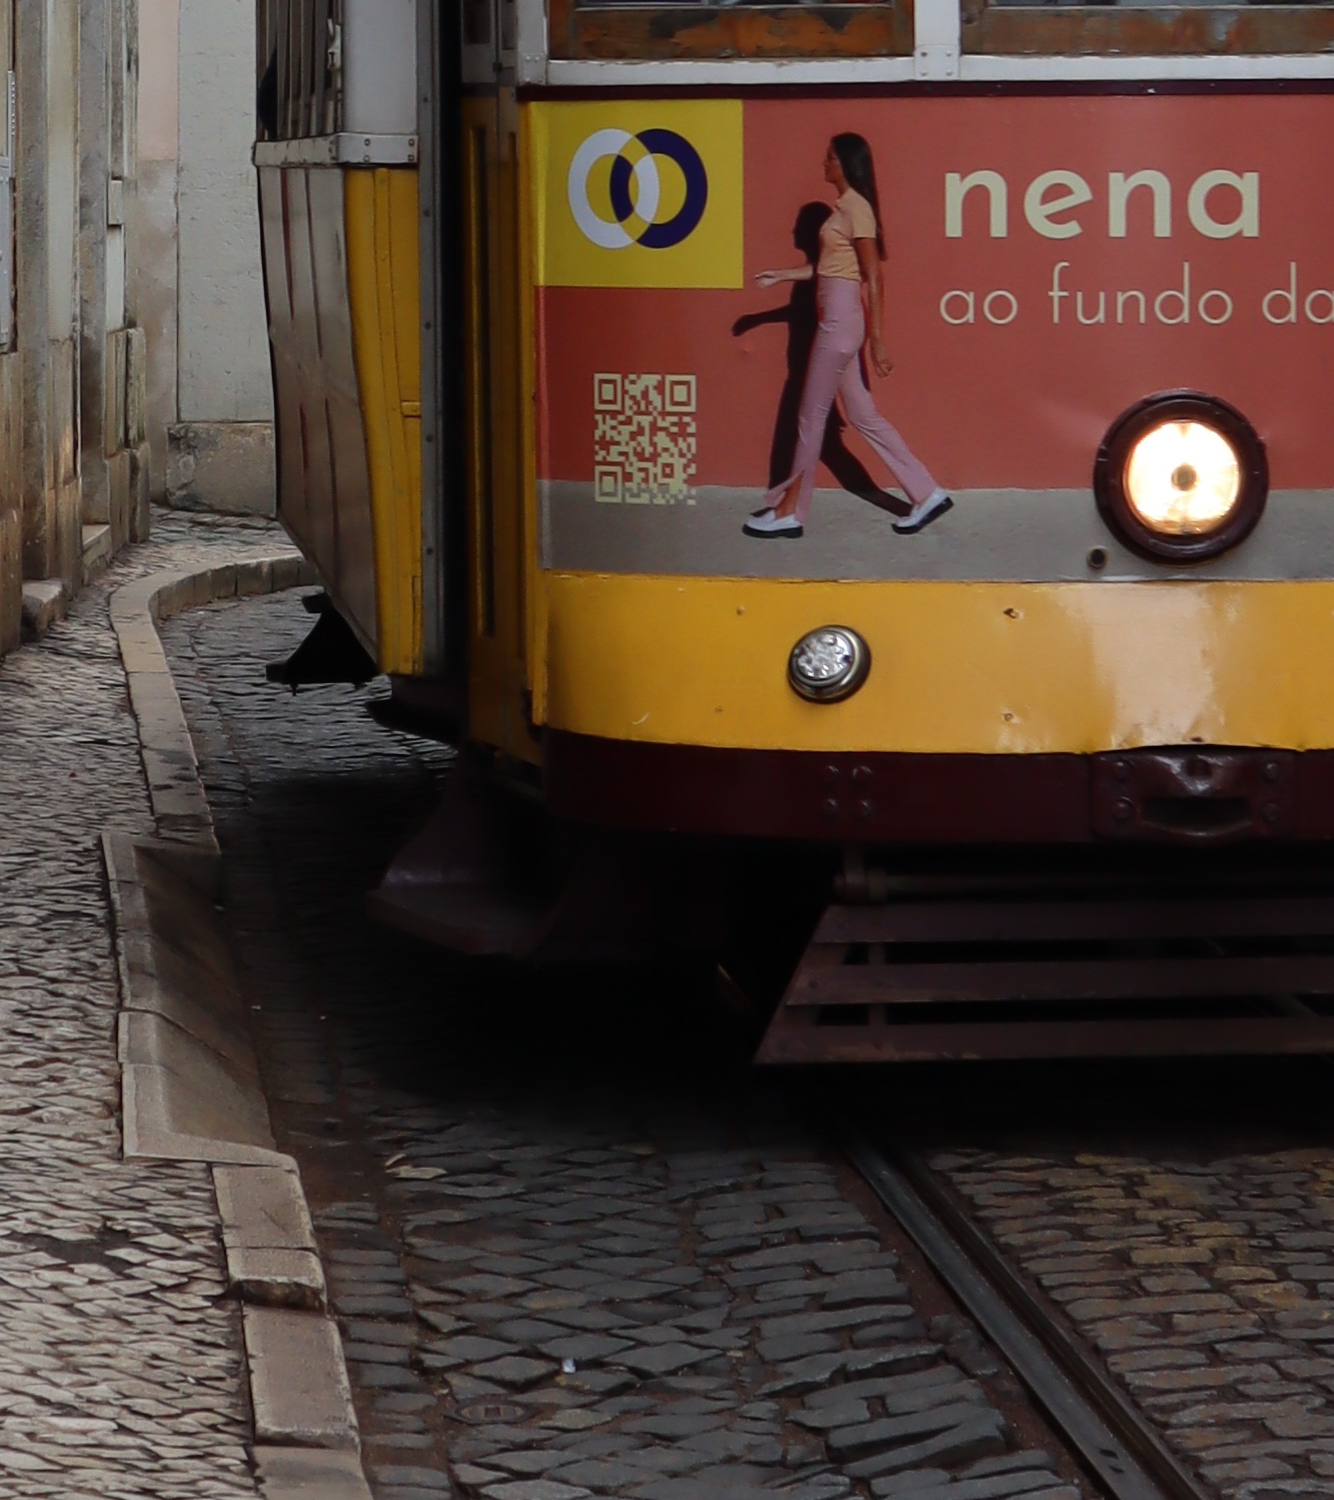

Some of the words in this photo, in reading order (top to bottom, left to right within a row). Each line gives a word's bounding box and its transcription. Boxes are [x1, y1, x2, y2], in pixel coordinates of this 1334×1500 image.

[944, 169, 1260, 239] nena
[939, 290, 1019, 325] ao
[1047, 261, 1234, 325] fundo
